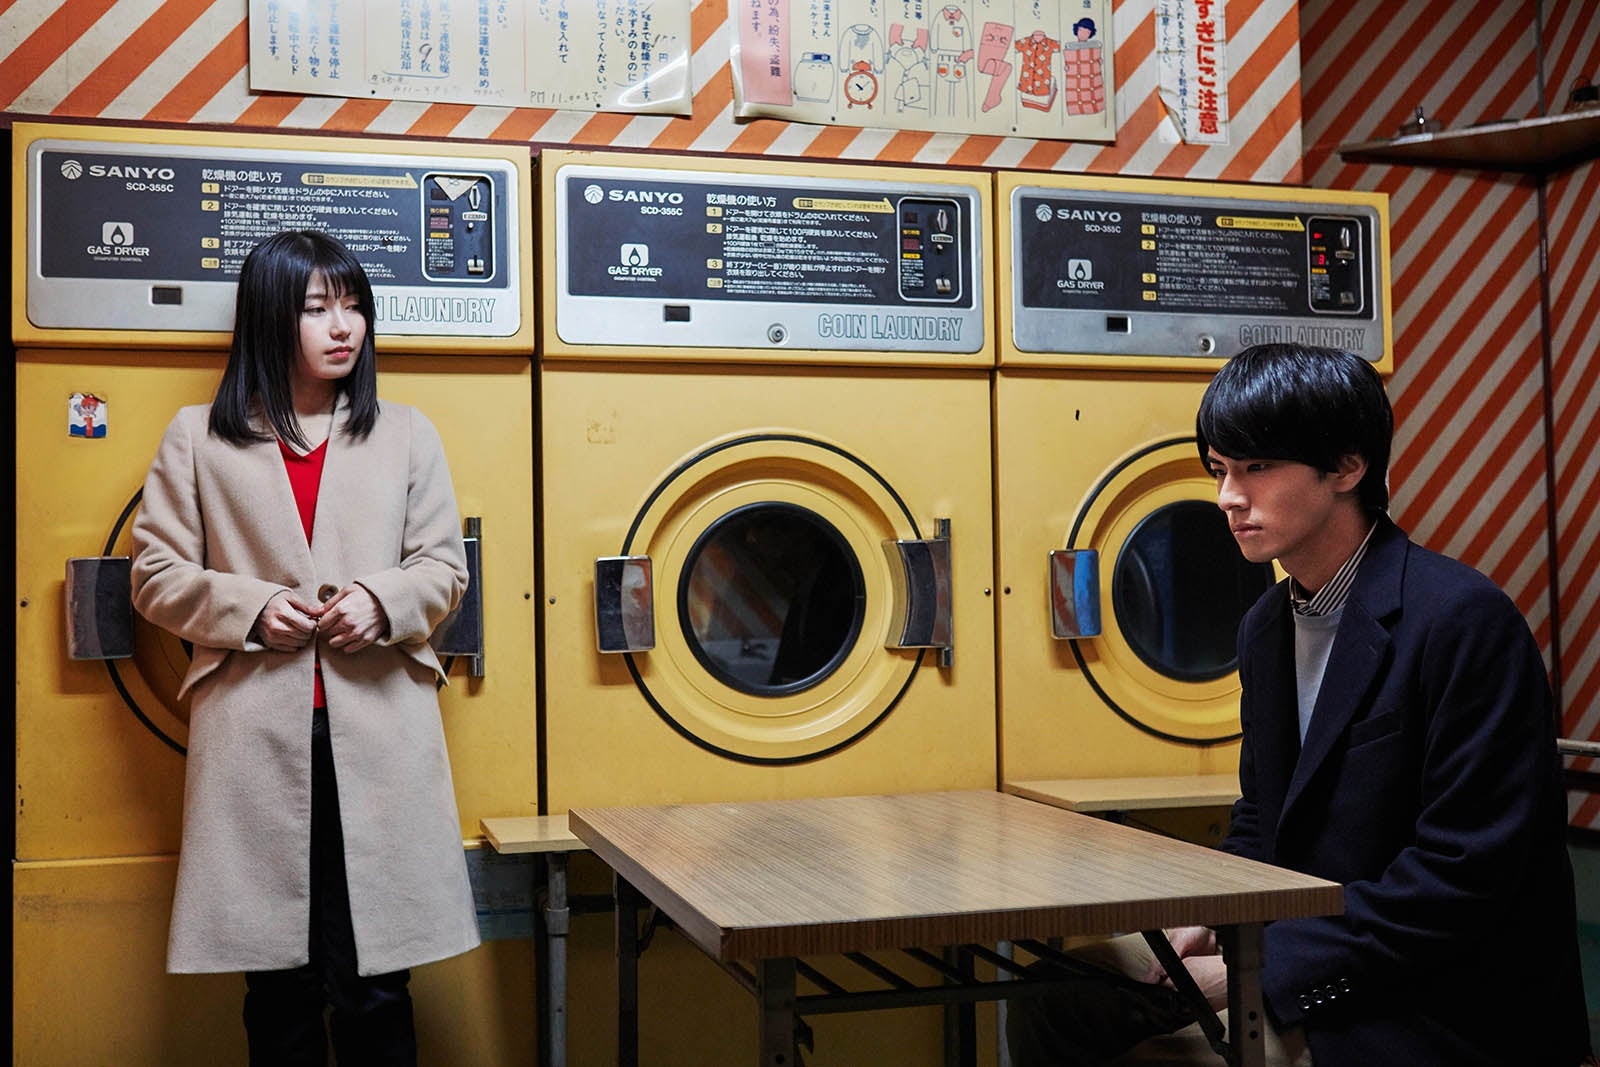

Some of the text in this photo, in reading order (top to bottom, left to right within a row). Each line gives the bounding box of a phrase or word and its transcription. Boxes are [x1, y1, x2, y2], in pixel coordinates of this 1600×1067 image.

[89, 165, 175, 180] SANYO
[201, 168, 283, 183] 乾燥機の使い方
[126, 182, 174, 192] SCD-355C
[608, 189, 684, 204] SANYO
[706, 193, 777, 207] 乾燥機の使い方
[207, 201, 214, 209] 2
[640, 206, 683, 216] SCD-355C
[1056, 208, 1122, 222] SANYO
[1084, 224, 1121, 233] SCD-355C
[207, 239, 214, 247] 3
[1146, 241, 1152, 249] 2
[87, 246, 150, 256] GAS DRYER
[711, 260, 718, 268] 3
[1318, 253, 1326, 265] 3
[607, 266, 663, 277] GAS DRYER
[1146, 274, 1153, 282] 3
[1057, 280, 1104, 289] GAS DRYER
[390, 296, 496, 323] LAUNDRY
[818, 313, 963, 341] COIN LAUNDRY
[1240, 324, 1365, 350] COIN LAUNDRY
